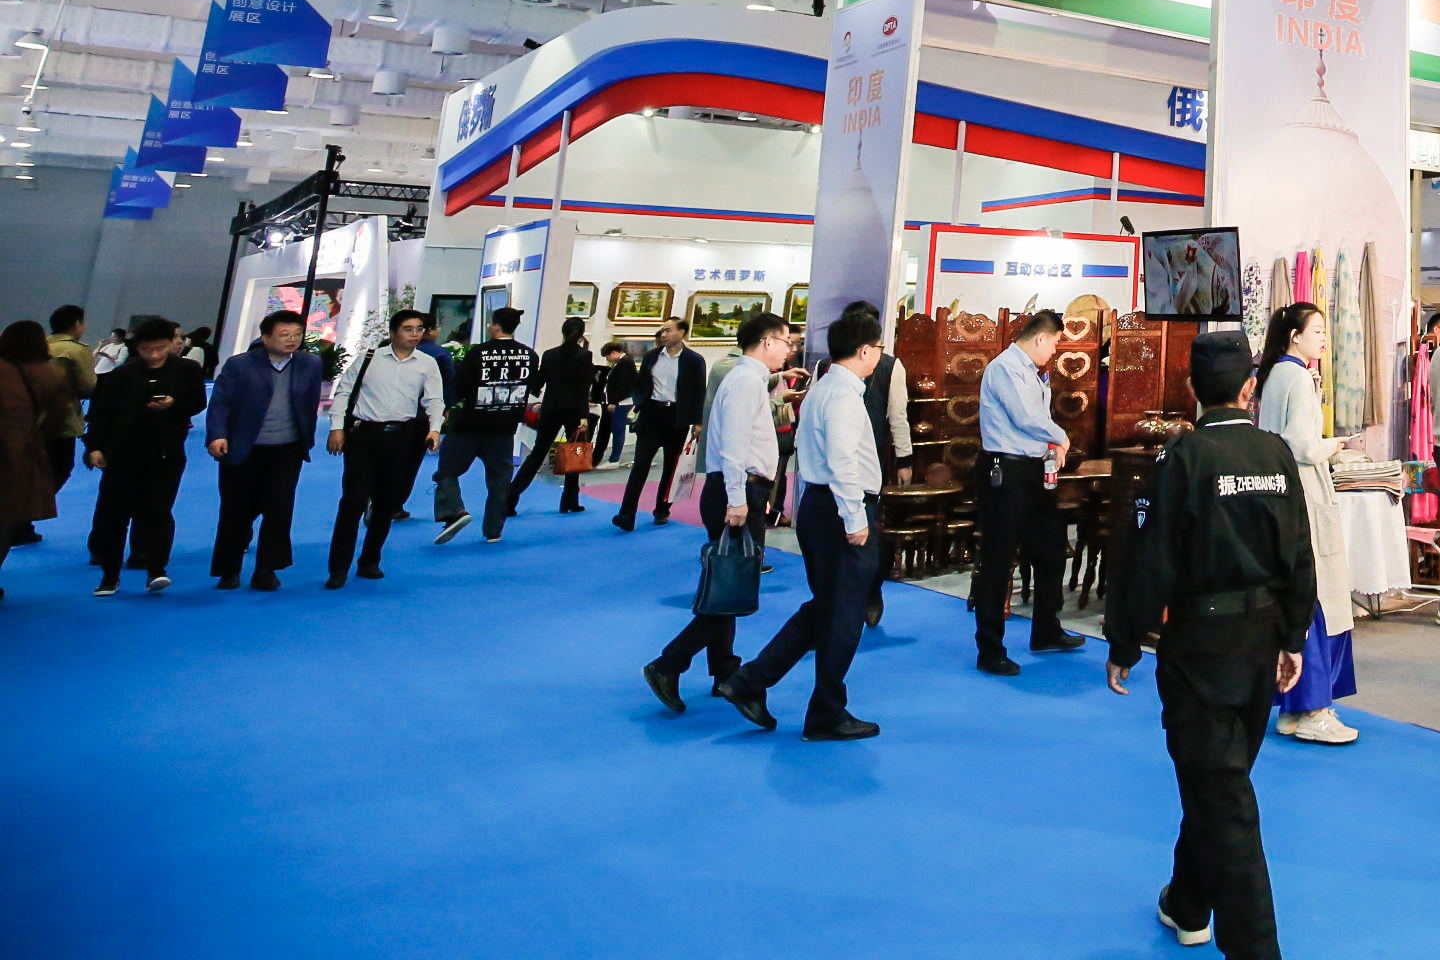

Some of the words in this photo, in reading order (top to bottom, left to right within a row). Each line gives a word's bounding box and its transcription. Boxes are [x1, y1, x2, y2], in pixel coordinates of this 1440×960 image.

[228, 10, 262, 24] 展区
[1275, 12, 1365, 58] INDIA
[202, 63, 230, 75] 展区
[847, 69, 885, 107] 印度
[843, 105, 882, 134] INDIA
[694, 268, 766, 282] 艺术俄罗斯
